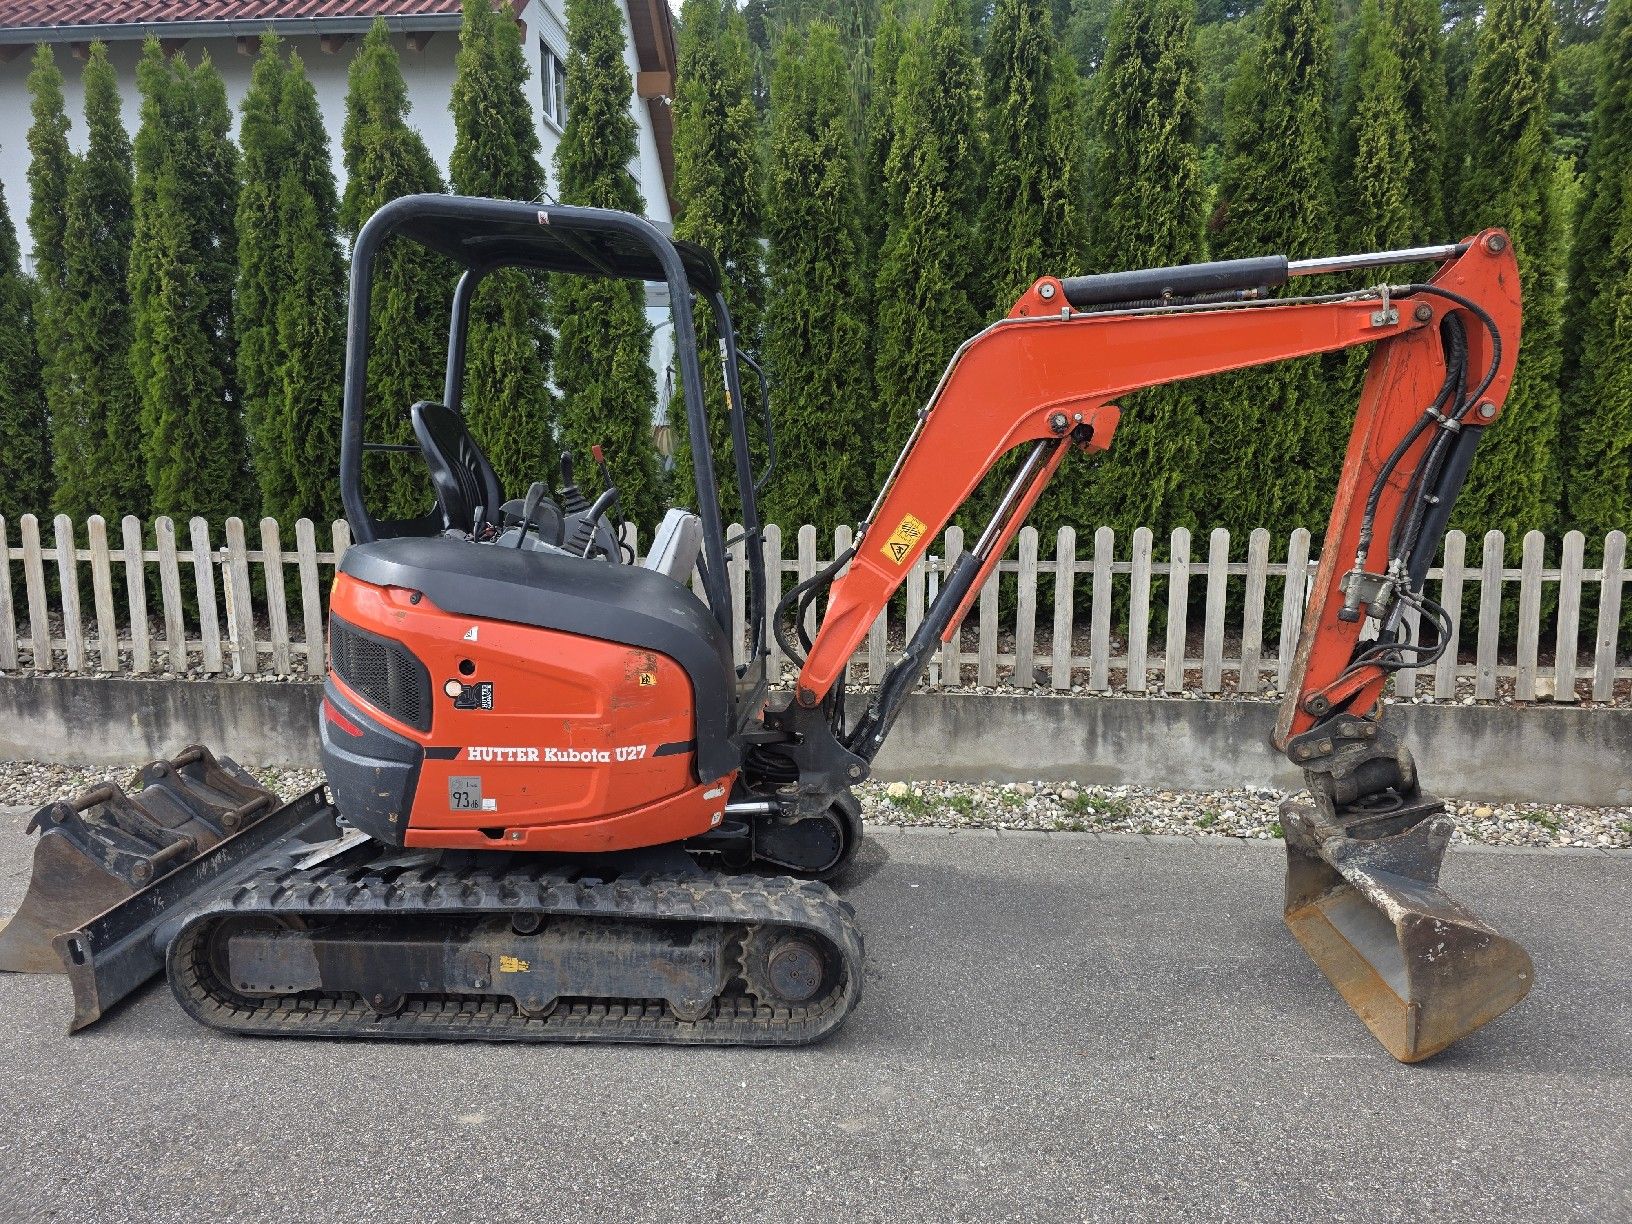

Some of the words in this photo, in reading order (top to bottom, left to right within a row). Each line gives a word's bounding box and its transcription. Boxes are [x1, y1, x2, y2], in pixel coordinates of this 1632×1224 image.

[467, 746, 539, 762] HUTTER
[544, 747, 611, 763] Kubota
[615, 744, 648, 762] U27
[453, 791, 470, 808] 93
